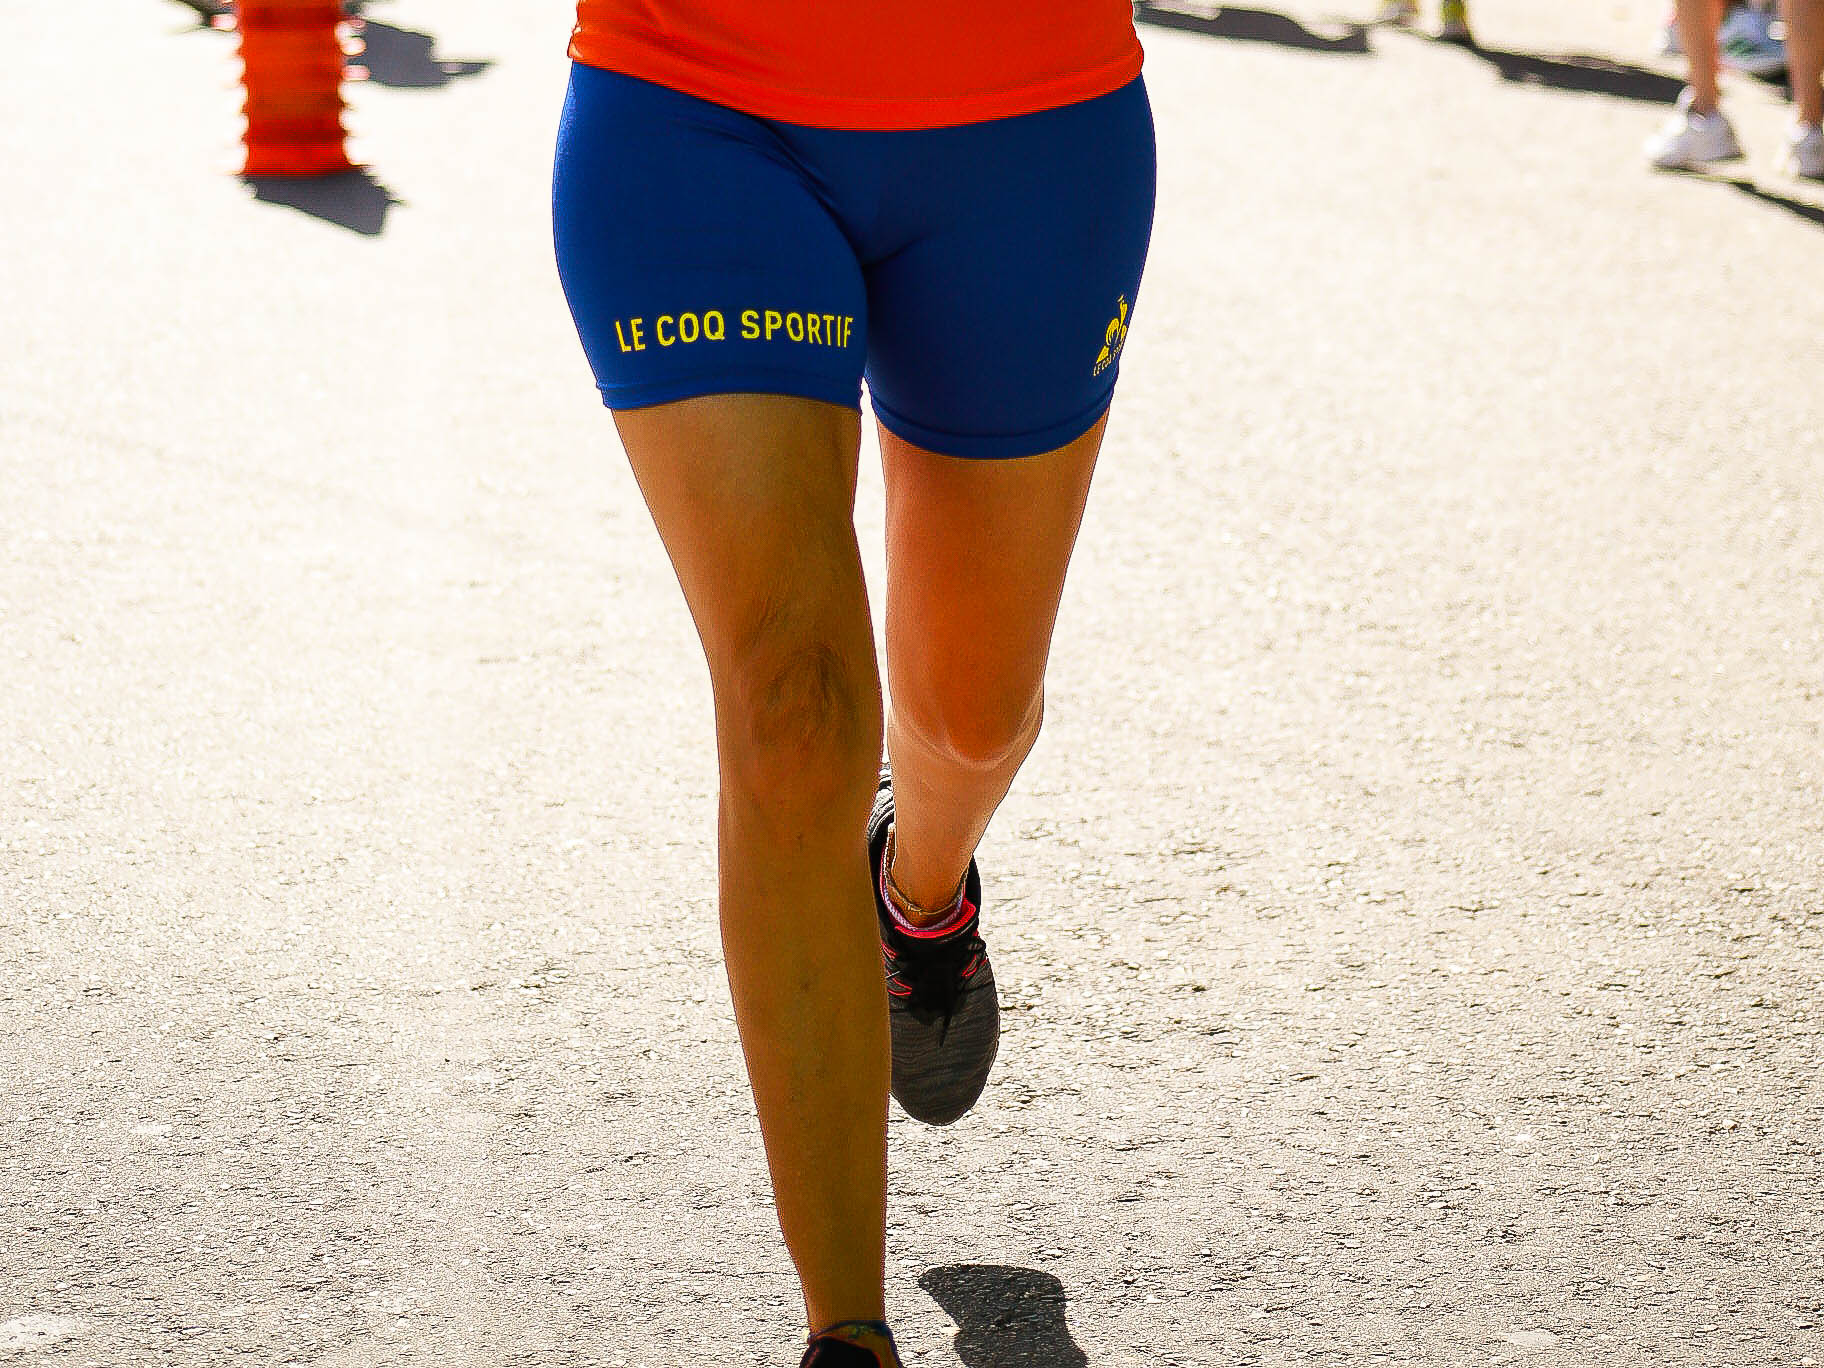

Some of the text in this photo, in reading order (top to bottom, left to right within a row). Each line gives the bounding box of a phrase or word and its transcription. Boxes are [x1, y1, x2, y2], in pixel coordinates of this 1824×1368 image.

[615, 310, 853, 353] LE COQ SPORTIF
